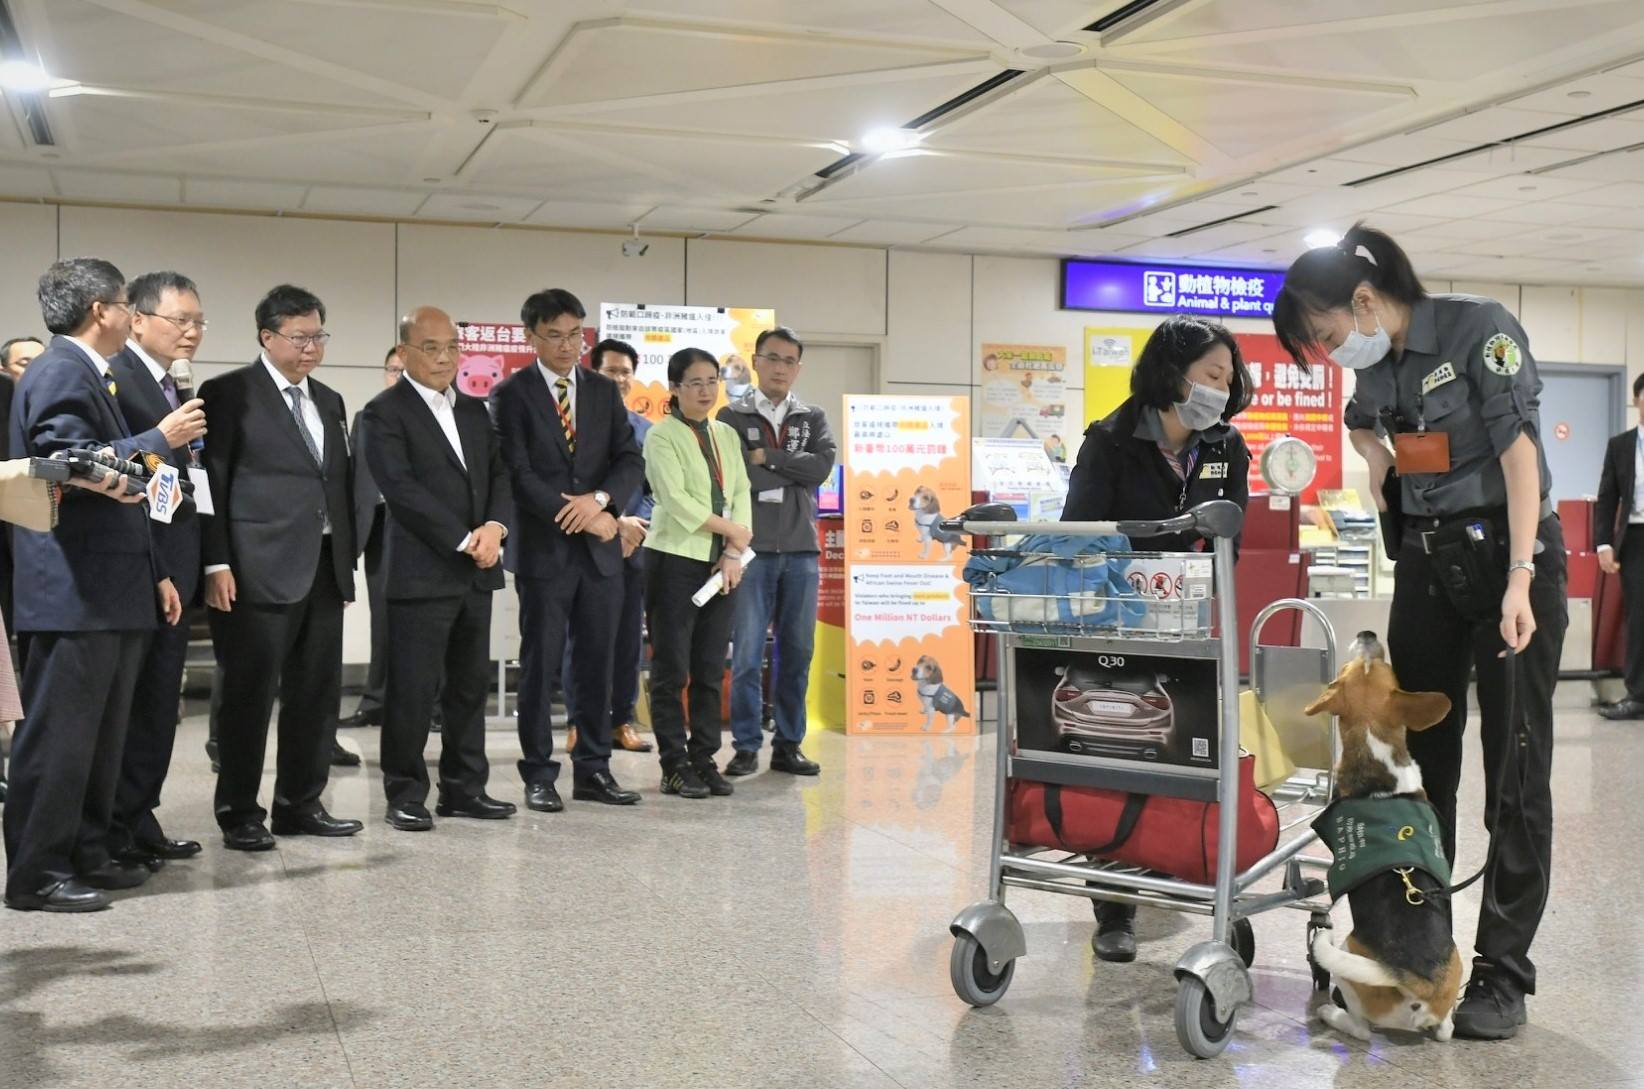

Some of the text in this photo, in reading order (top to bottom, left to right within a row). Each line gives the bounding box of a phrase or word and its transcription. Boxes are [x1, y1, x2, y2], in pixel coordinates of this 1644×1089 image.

[1178, 274, 1265, 297] 動植物檢疫
[1178, 296, 1219, 310] Animal
[1221, 298, 1229, 310] &
[1232, 299, 1261, 312] plant
[643, 354, 664, 365] 100
[1262, 394, 1275, 407] or
[1277, 391, 1292, 407] be
[157, 472, 175, 516] TVBS
[855, 613, 951, 622] One Million NT Dollars
[1098, 655, 1125, 668] Q30
